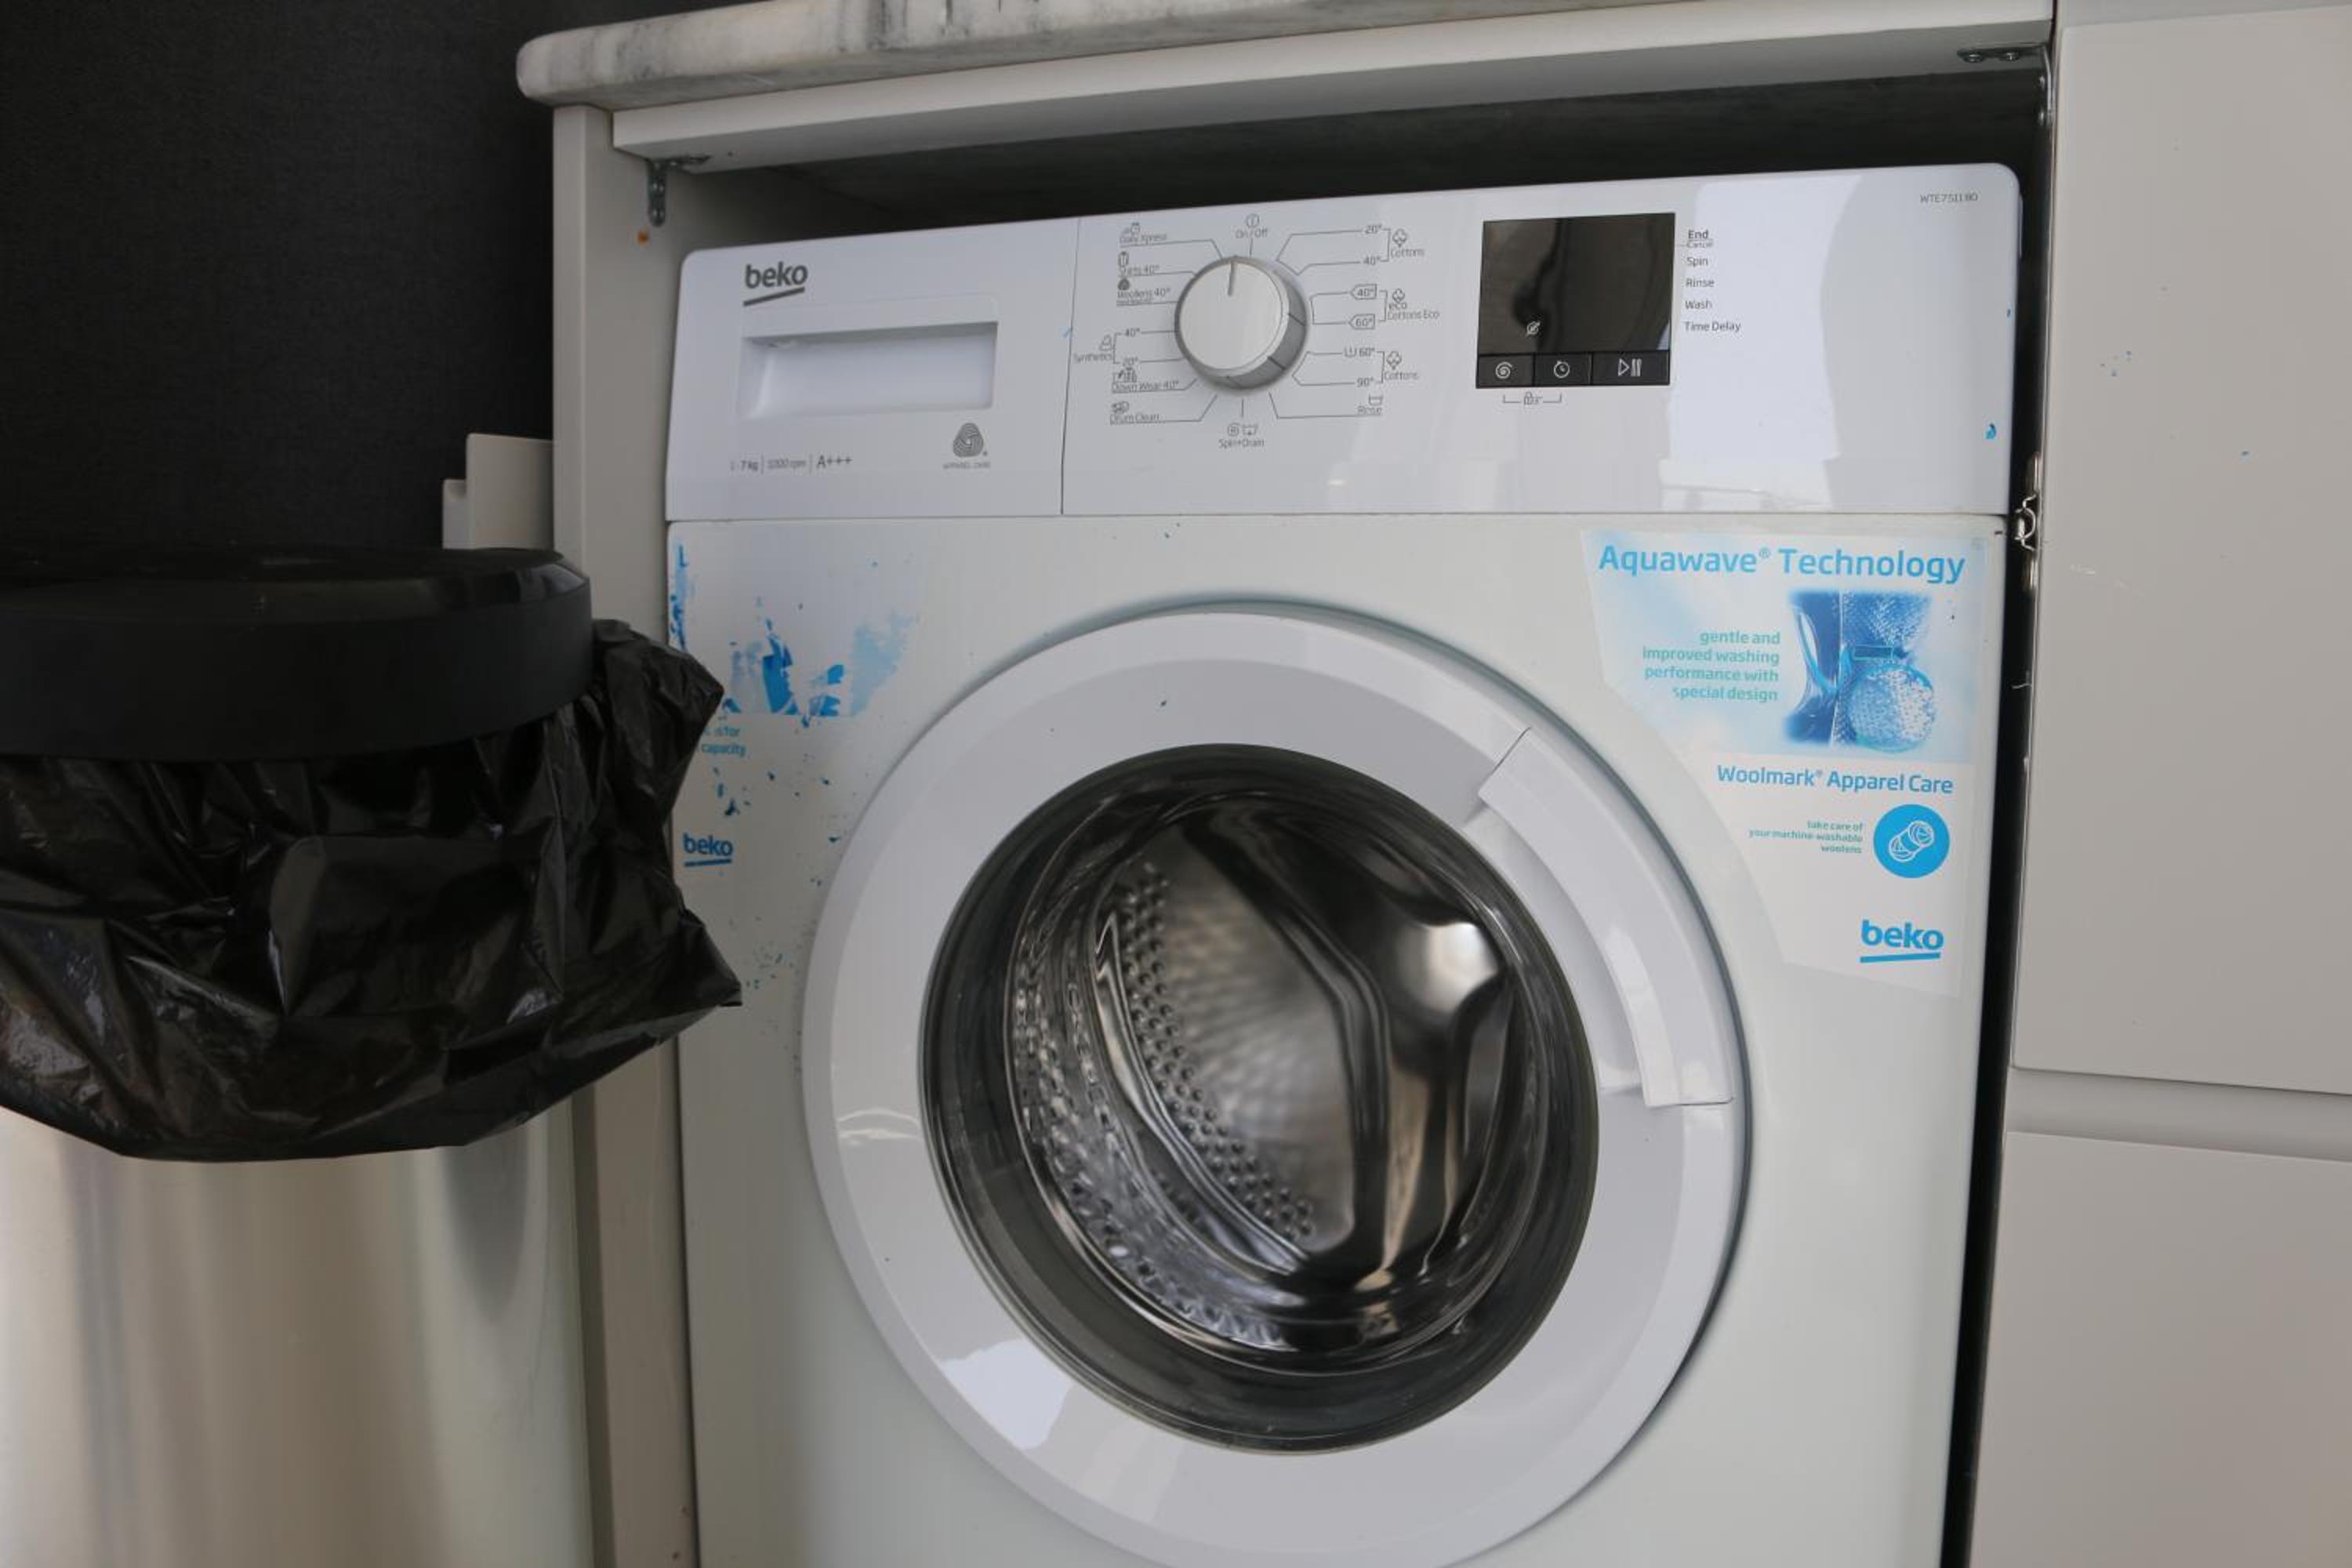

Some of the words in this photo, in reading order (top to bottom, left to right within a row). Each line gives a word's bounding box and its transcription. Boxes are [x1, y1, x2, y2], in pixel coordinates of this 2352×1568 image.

[1688, 229, 1708, 239] End
[1391, 248, 1425, 258] Cottons
[1363, 256, 1381, 265] 40°
[1686, 256, 1708, 267] Spin
[746, 261, 808, 289] beko
[1686, 278, 1715, 288] Rinse
[1153, 288, 1171, 296] 40°
[1357, 288, 1374, 297] 40°
[1388, 301, 1407, 310] eco
[1685, 299, 1712, 310] Wash
[1388, 311, 1421, 321] Cottons
[1423, 310, 1440, 319] Eco
[1356, 318, 1374, 327] 60°
[1684, 321, 1710, 332] Time
[1711, 321, 1741, 333] Delay
[1385, 371, 1419, 380] Cottons
[1356, 377, 1374, 387] 90°
[817, 455, 853, 469] A+++
[1779, 548, 1965, 584] Technology
[1700, 630, 1750, 645] gentle
[1752, 631, 1780, 645] and
[1643, 646, 1712, 662] improved
[1716, 650, 1780, 666] washing
[1645, 666, 1741, 681] performance
[1745, 669, 1779, 682] with
[1673, 686, 1724, 700] special
[1728, 686, 1777, 703] design
[1827, 771, 1904, 792] Apparel
[1909, 775, 1953, 793] Care
[1830, 822, 1852, 830] care
[1853, 822, 1863, 831] of
[1748, 829, 1769, 839] your
[683, 833, 733, 856] beko
[1861, 919, 1944, 950] beko
